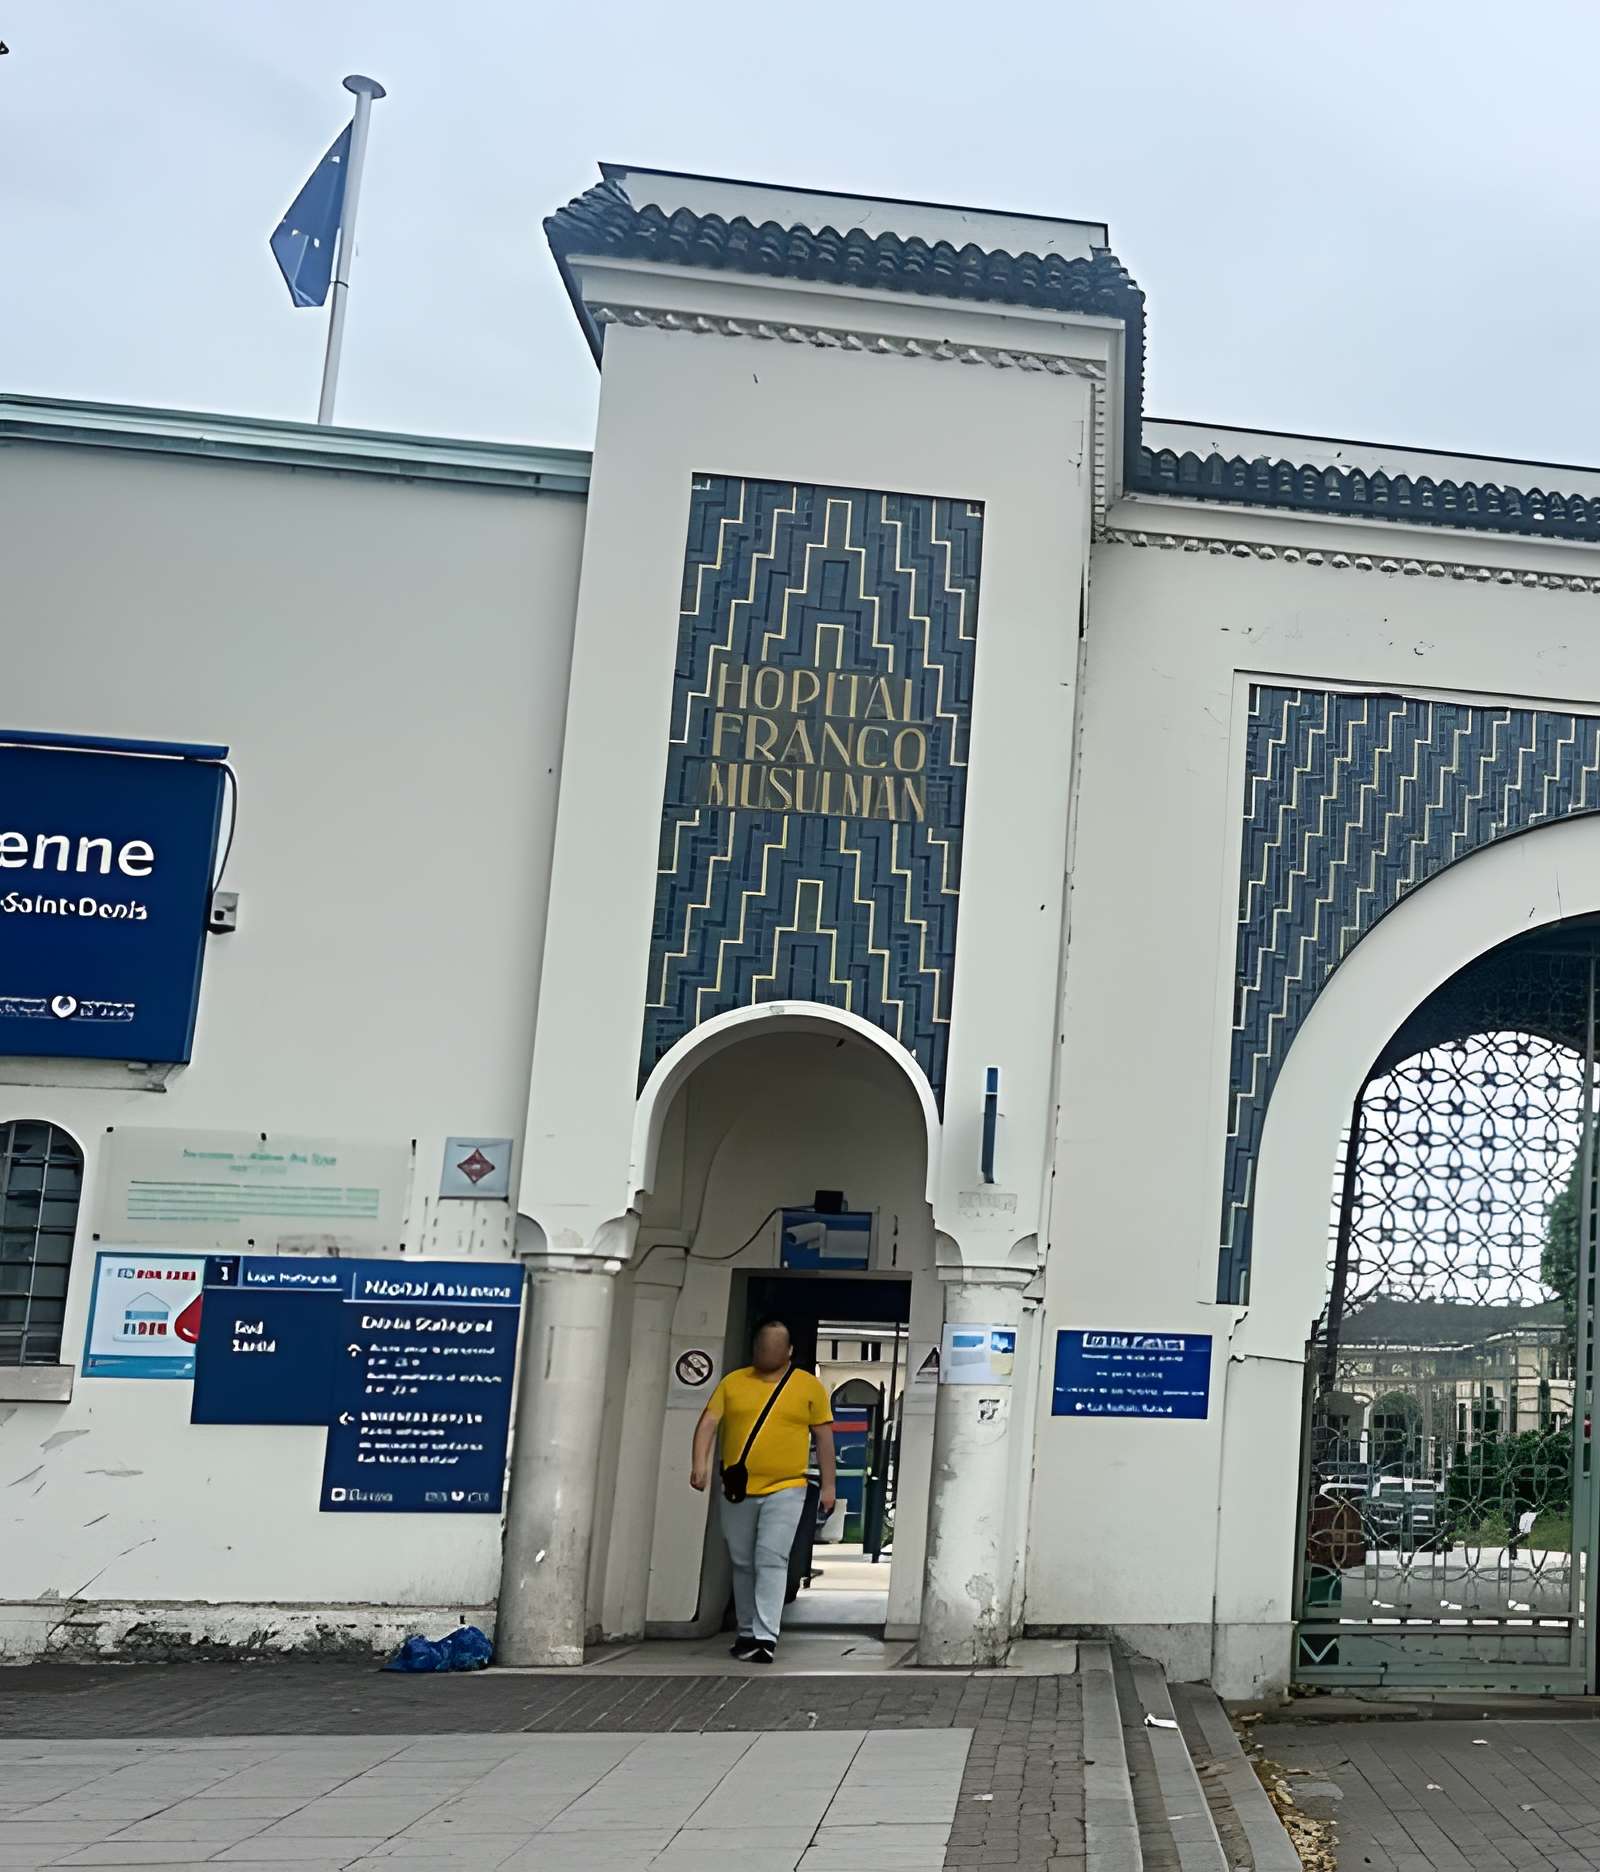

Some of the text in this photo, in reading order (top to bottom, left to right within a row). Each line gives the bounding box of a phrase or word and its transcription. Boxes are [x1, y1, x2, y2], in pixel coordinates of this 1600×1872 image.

[715, 662, 931, 721] HOPITAL
[711, 711, 926, 773] FRANCO
[707, 761, 927, 823] MUSULMAN
